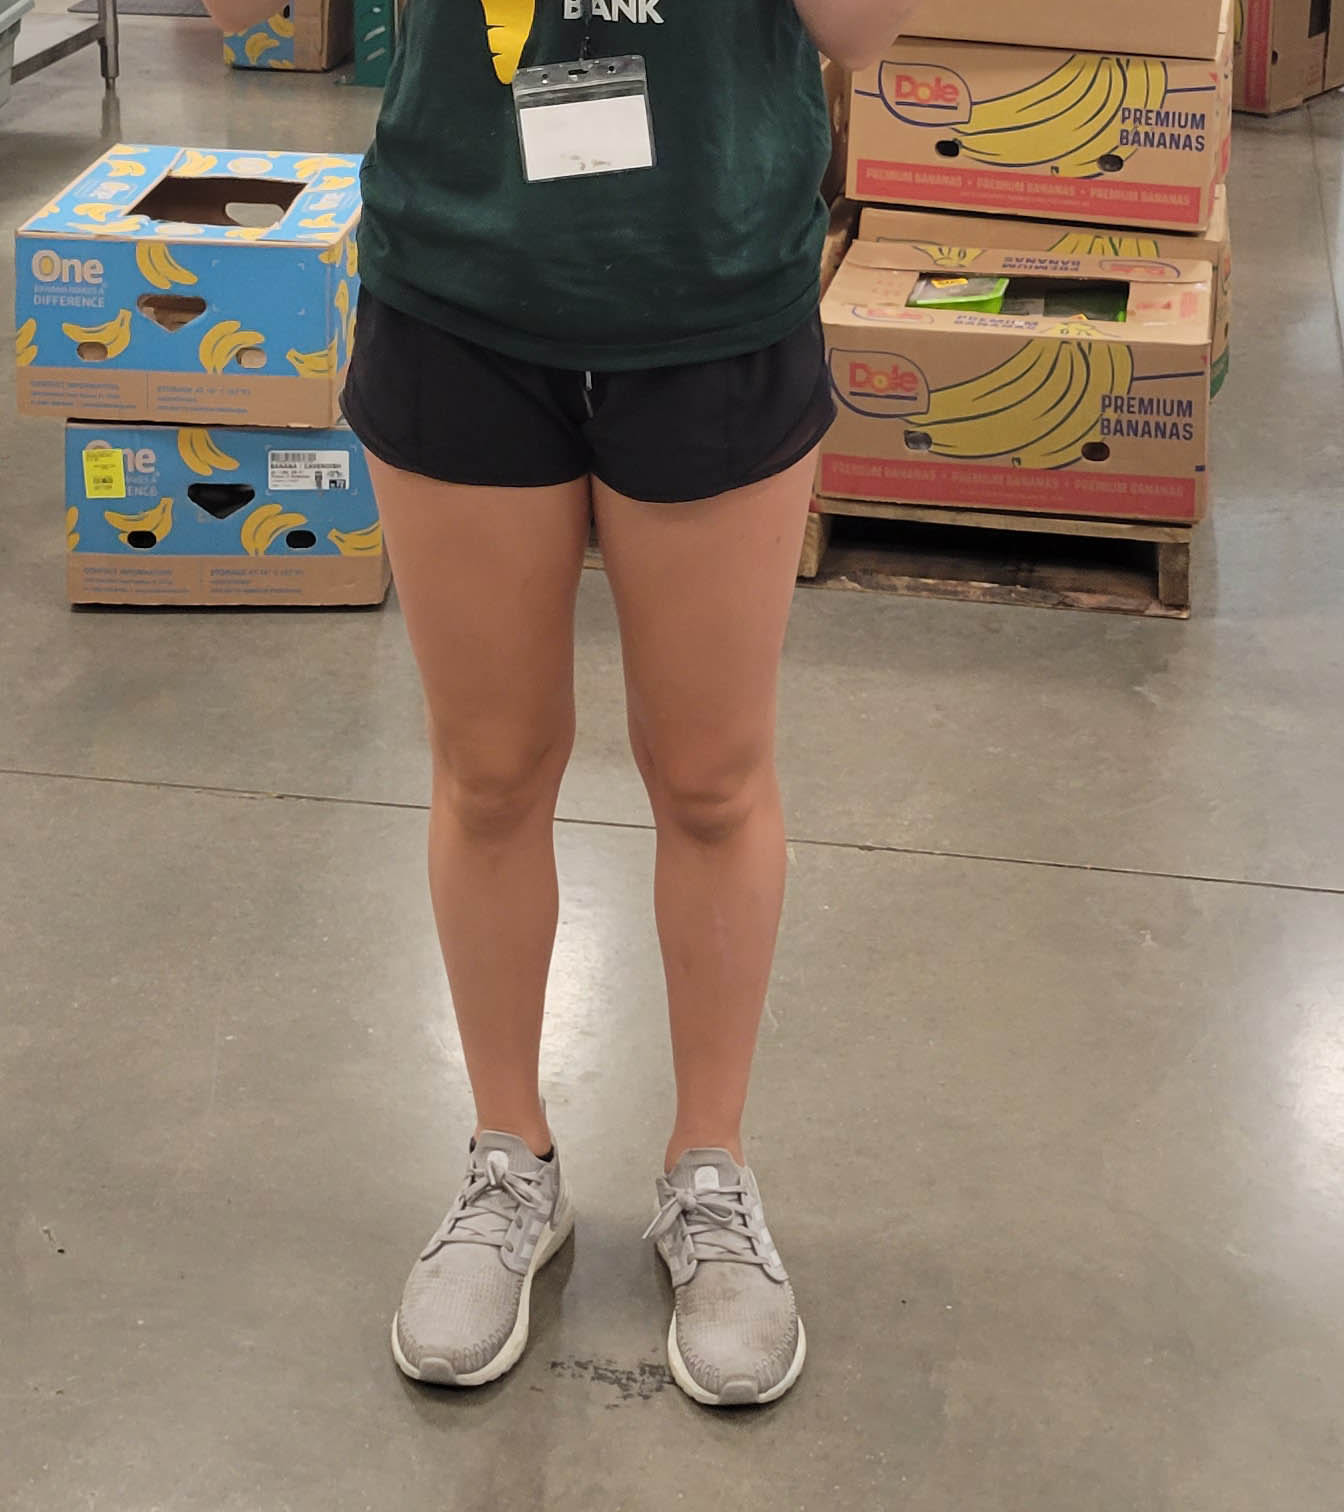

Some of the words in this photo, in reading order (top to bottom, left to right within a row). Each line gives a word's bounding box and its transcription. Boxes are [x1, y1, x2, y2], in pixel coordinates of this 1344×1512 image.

[894, 73, 960, 103] Dole
[1121, 107, 1206, 130] PREMIUM
[1119, 129, 1206, 152] BANANAS
[31, 249, 105, 285] One
[33, 294, 105, 308] DIFFERENCE
[849, 362, 919, 394] Dole
[1101, 394, 1194, 418] PREMIUM
[1100, 418, 1194, 441] BANANAS
